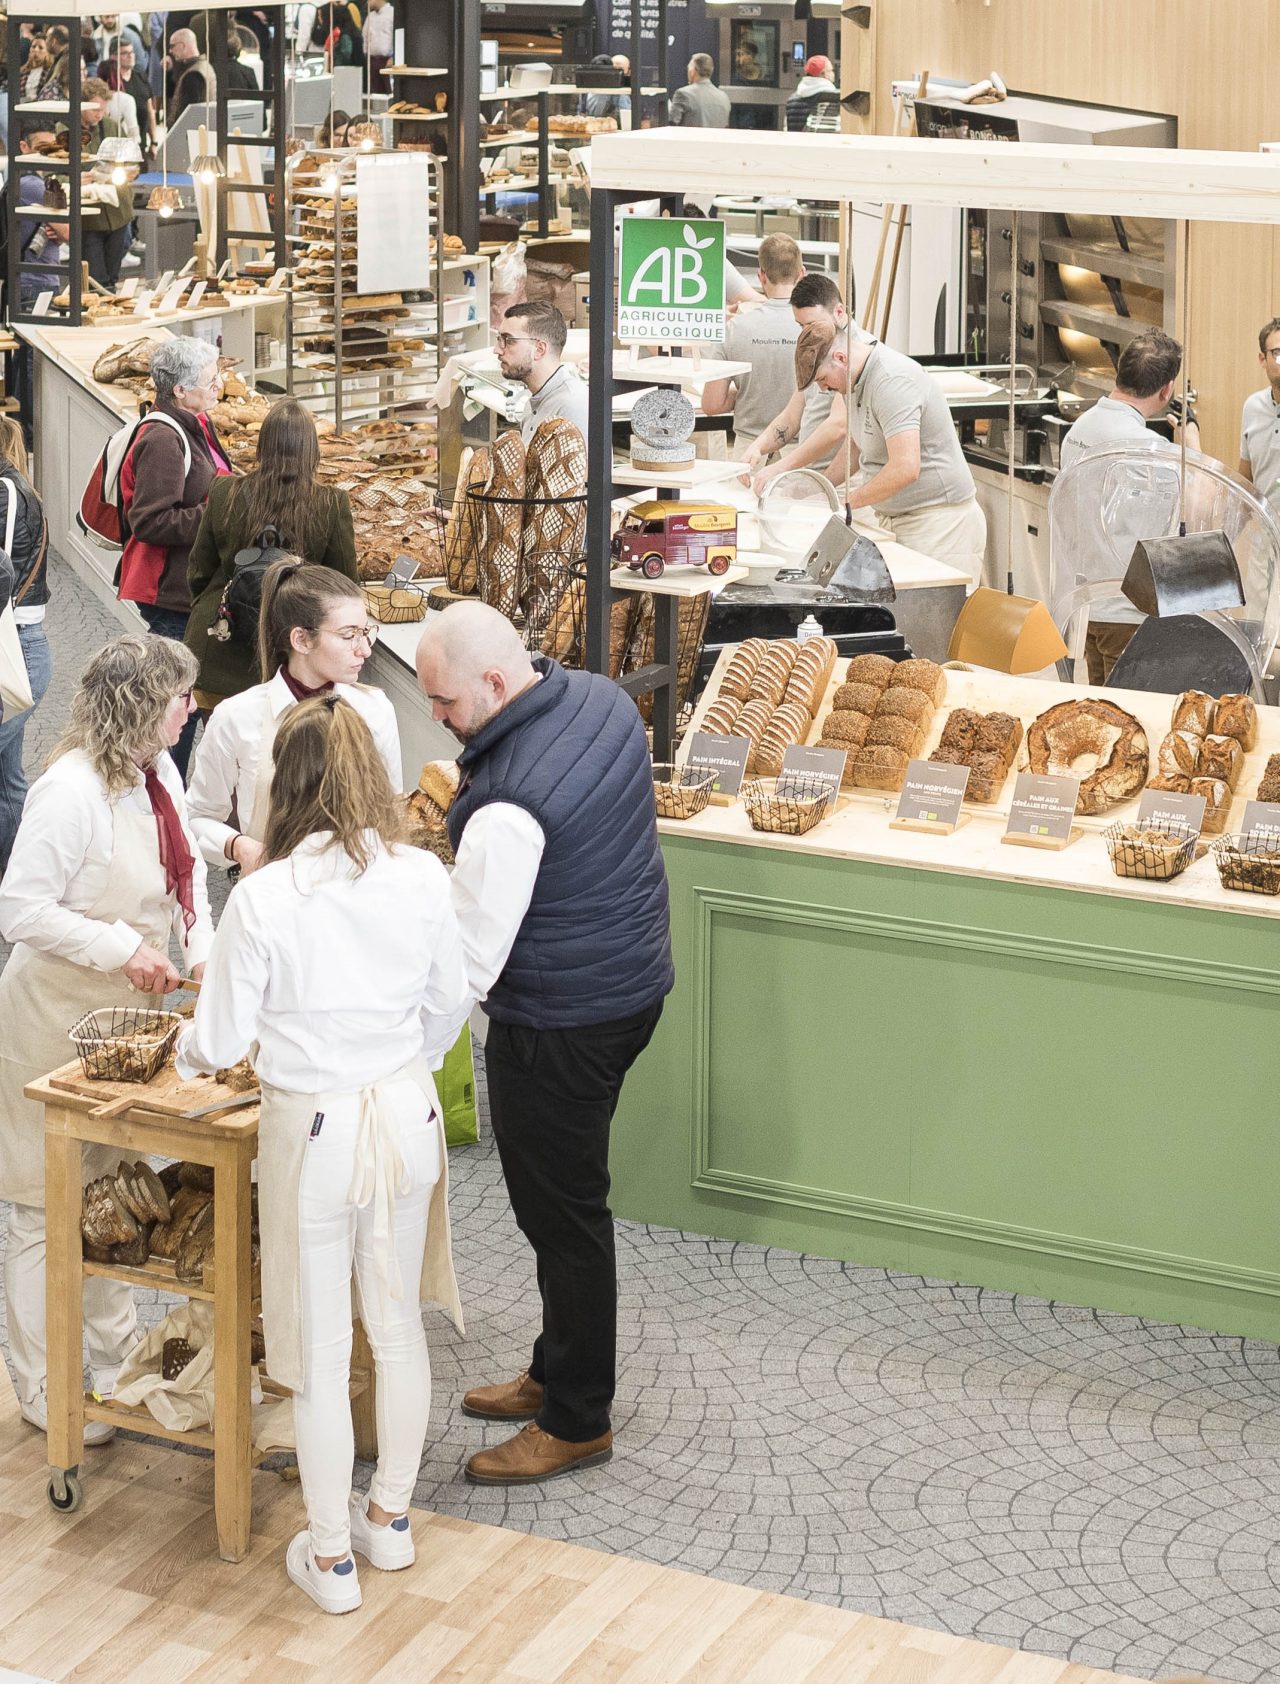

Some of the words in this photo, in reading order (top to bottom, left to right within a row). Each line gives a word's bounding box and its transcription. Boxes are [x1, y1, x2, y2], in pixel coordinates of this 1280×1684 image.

[969, 129, 1010, 141] BONGARD
[627, 246, 708, 305] AB
[620, 310, 724, 324] AGRICULTURE
[620, 325, 724, 338] BIOLOGIQUE
[692, 755, 707, 763] PAIN
[708, 758, 740, 767] INTÉGRAL
[783, 768, 799, 776] PAIN
[800, 770, 840, 780] NORVÉGIEN
[906, 781, 922, 791] PAIN
[924, 784, 963, 795] NORVÉGIEN
[1012, 799, 1041, 809] CÉRÉALES
[1029, 794, 1045, 803] PAIN
[1045, 796, 1060, 804] AUX
[1153, 810, 1171, 819] PAIN
[1171, 813, 1187, 821] AUX
[1255, 822, 1273, 831] PAIN
